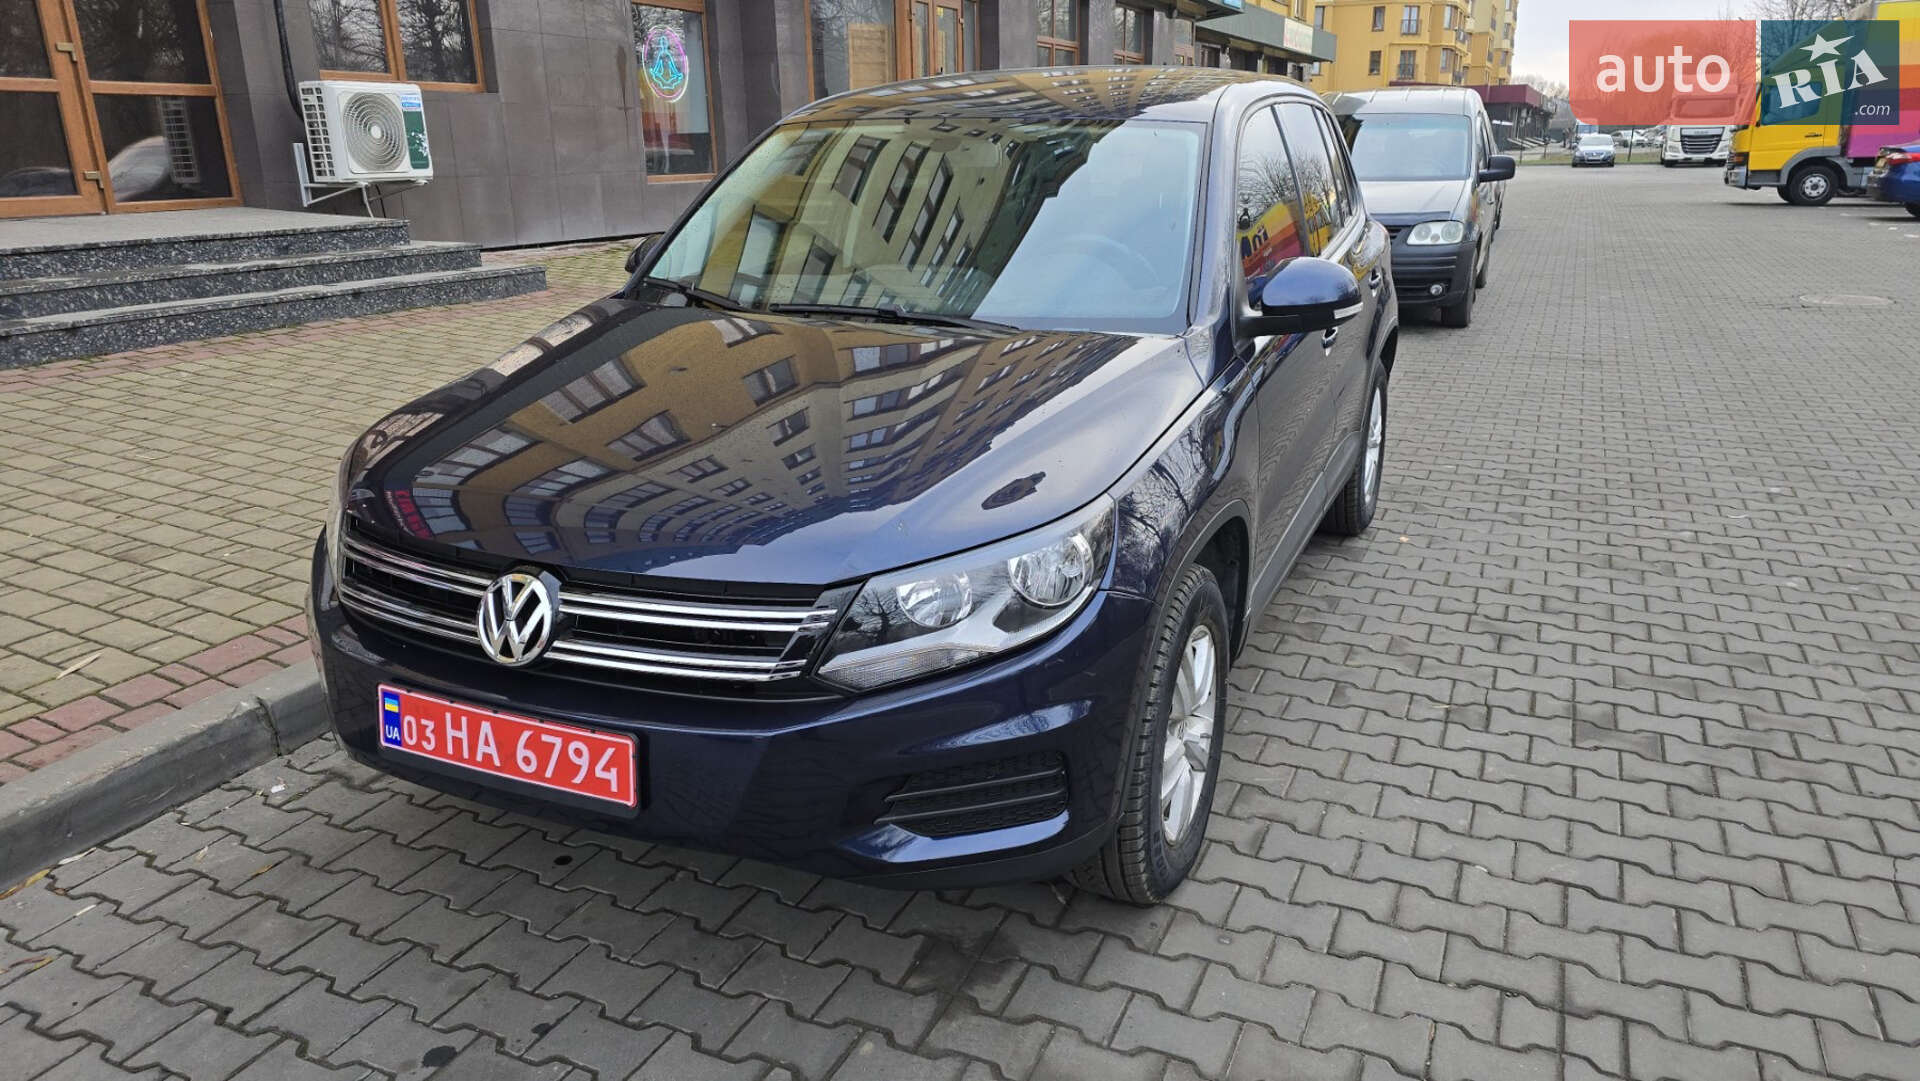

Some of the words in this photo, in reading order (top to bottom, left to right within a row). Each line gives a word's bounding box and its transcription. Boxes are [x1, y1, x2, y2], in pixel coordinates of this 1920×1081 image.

[385, 725, 400, 741] UA
[403, 714, 436, 751] 03
[445, 711, 501, 767] HA
[516, 730, 619, 793] 6794
